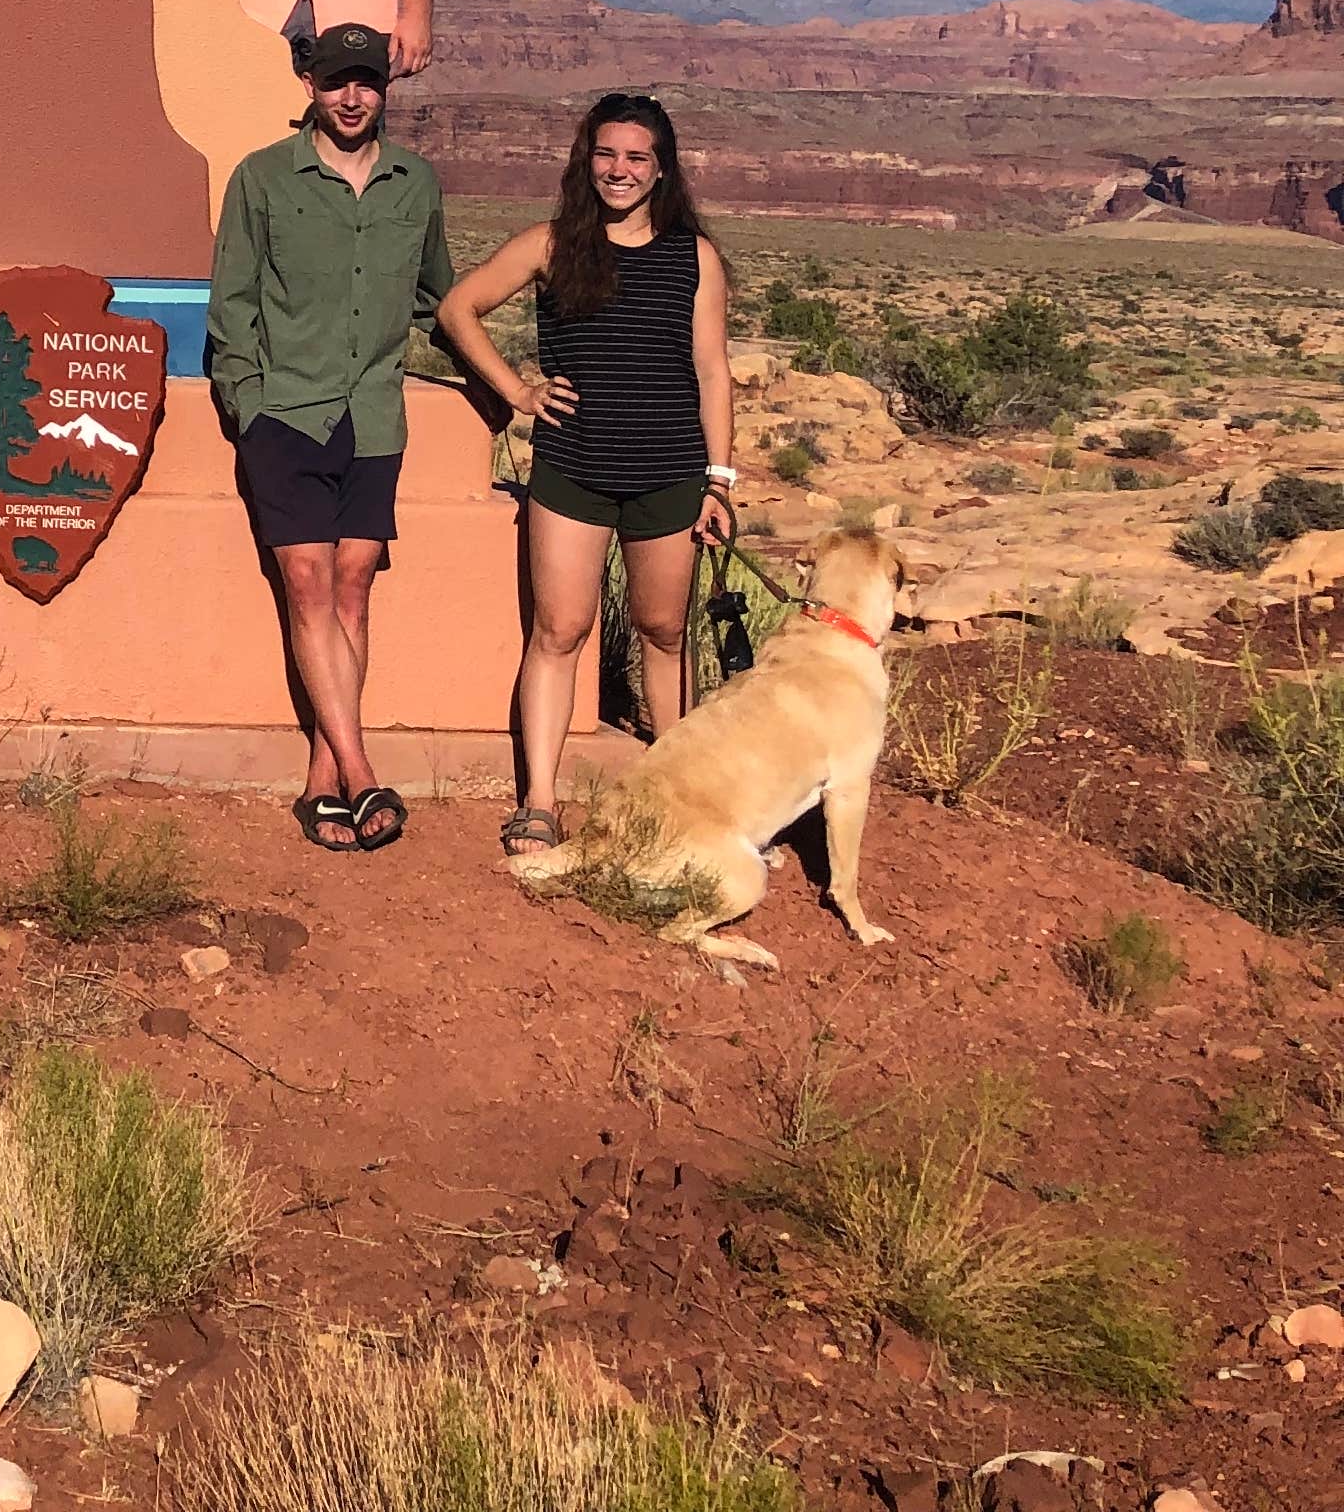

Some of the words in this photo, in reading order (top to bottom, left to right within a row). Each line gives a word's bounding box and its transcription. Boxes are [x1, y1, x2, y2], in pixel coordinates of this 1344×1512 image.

[43, 332, 154, 354] NATIONAL
[68, 362, 127, 381] PARK
[48, 389, 149, 411] SERVICE
[5, 504, 82, 517] DEPARTMENT
[15, 516, 37, 528] THE
[42, 518, 96, 530] INTERIOR
